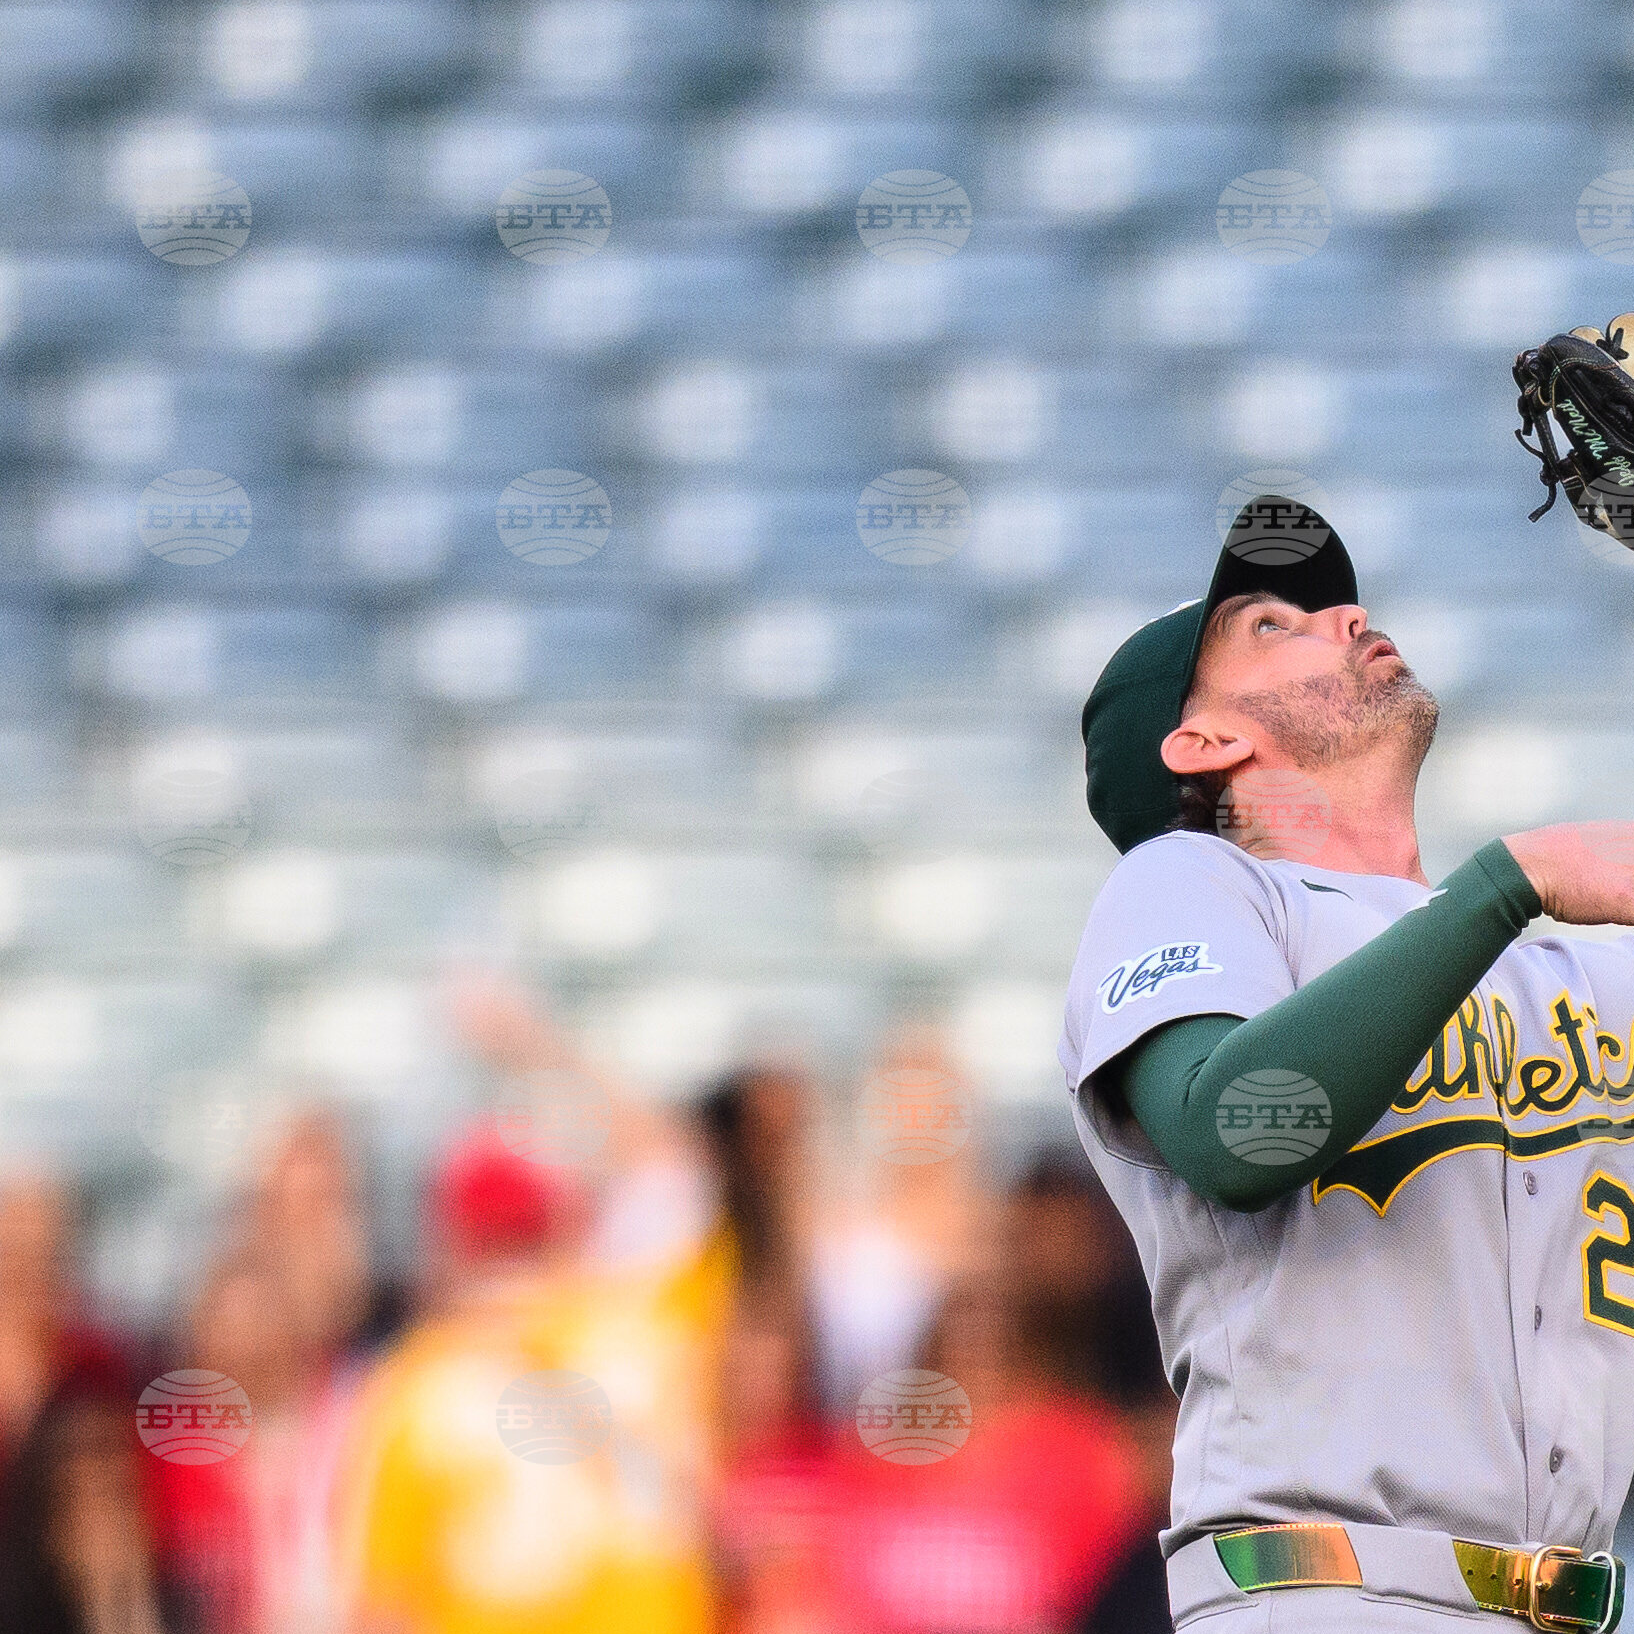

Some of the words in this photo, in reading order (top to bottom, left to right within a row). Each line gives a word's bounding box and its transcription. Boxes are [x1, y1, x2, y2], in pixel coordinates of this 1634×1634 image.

[1556, 398, 1609, 460] McNeil
[1100, 952, 1214, 1008] Vegas
[1160, 945, 1201, 963] LAS
